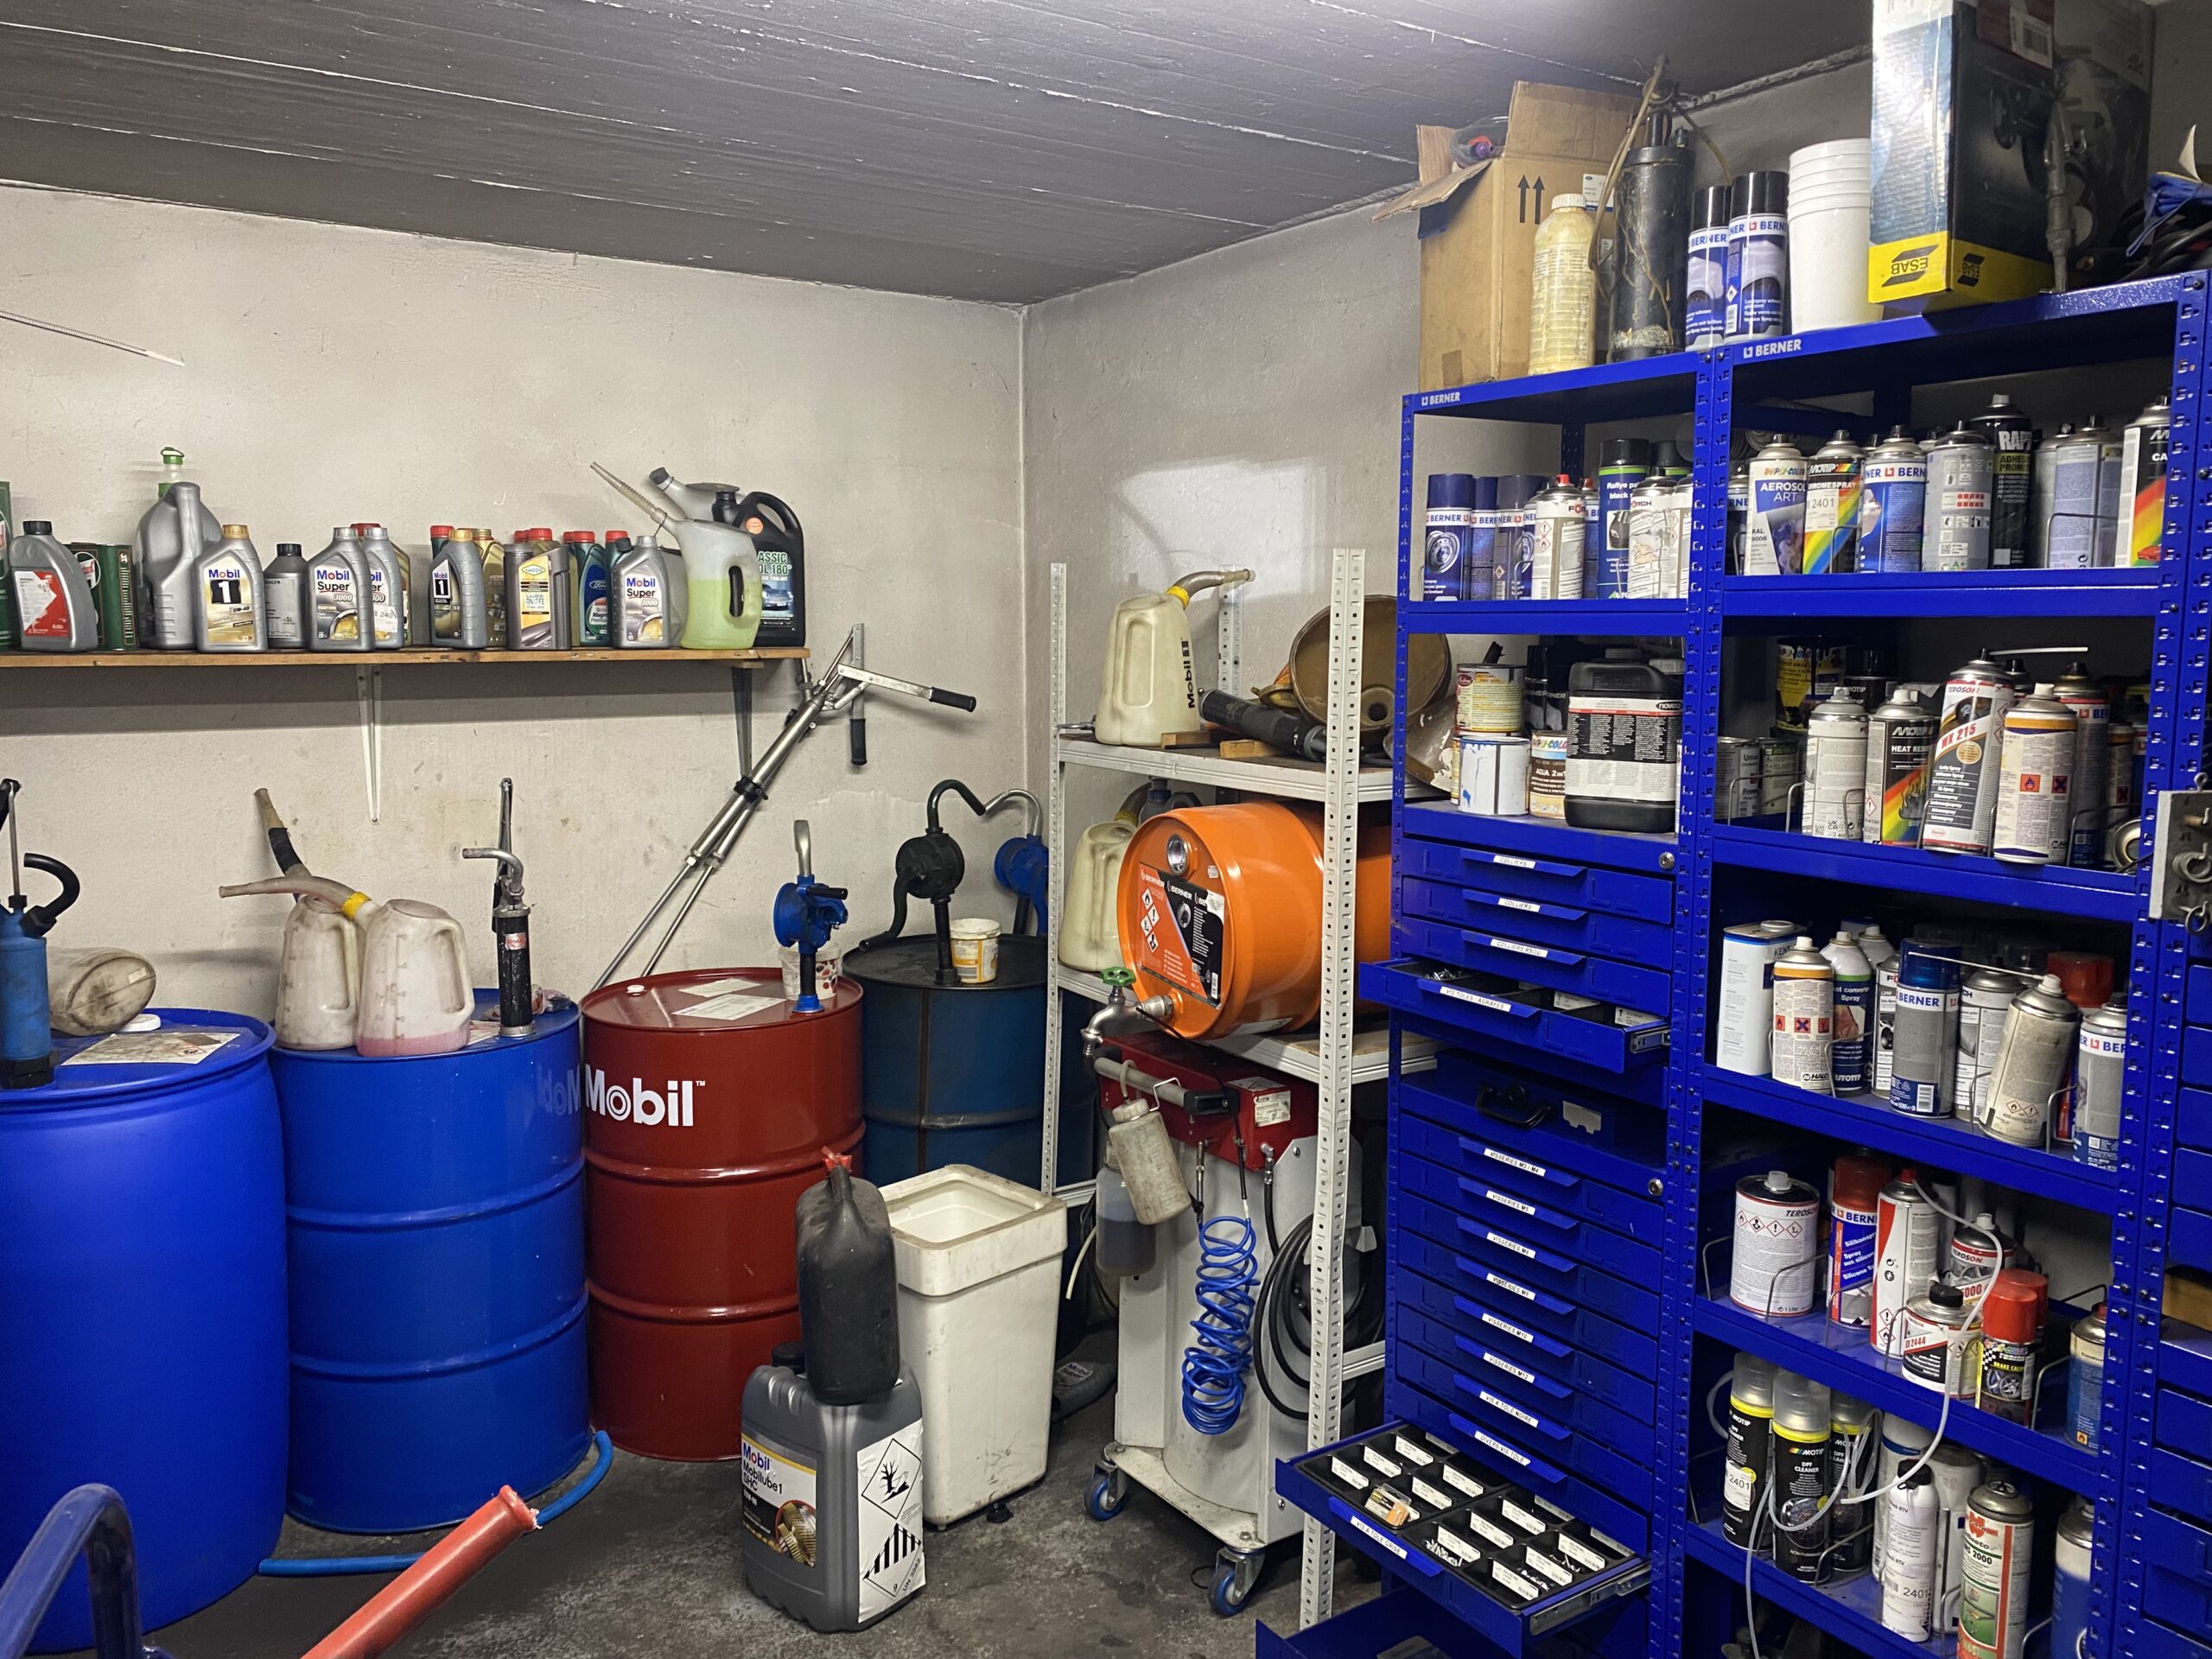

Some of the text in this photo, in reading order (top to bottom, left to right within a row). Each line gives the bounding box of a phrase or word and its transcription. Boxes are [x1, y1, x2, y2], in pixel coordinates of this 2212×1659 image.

[1691, 232, 1726, 246] BERNER
[1891, 257, 1928, 275] ESAB
[1755, 340, 1802, 356] BERNER
[1429, 392, 1460, 405] BERNER
[1760, 481, 1806, 492] AEROSOL
[1773, 492, 1797, 502] ART
[208, 569, 240, 578] Mobil
[316, 569, 350, 580] Mobil
[317, 581, 350, 592] Super
[438, 580, 445, 595] 1
[626, 577, 656, 588] Mobil
[218, 581, 232, 603] 1
[334, 594, 353, 602] 3000
[626, 588, 656, 598] Super
[1183, 660, 1195, 709] Mobil
[1956, 724, 1976, 741] 215
[1499, 857, 1527, 867] COLLIERS
[1144, 874, 1166, 888] BERNER
[1170, 884, 1192, 900] BERNER
[1504, 899, 1532, 910] COLLIERS
[1497, 941, 1524, 952] COLLIERS
[1478, 997, 1504, 1010] AGRAFES
[1898, 992, 1940, 1007] BERNER
[585, 1063, 694, 1127] Mobil
[1490, 1151, 1518, 1166] VISSERIES
[1492, 1193, 1520, 1209] VISSERIES
[1492, 1236, 1521, 1251] VISSERIES
[1843, 1250, 1862, 1260] Spray
[1953, 1249, 1983, 1263] TEROSON
[1492, 1276, 1521, 1294] VISSERIES
[1488, 1317, 1528, 1339] VISSERIES M10
[1489, 1356, 1529, 1380] VISSERIES M12
[1500, 1402, 1515, 1414] TOLE
[1515, 1411, 1532, 1424] NOIRE
[743, 1442, 770, 1471] Mobil
[1480, 1435, 1524, 1464] DIVERS VIS TOLE
[743, 1472, 758, 1491] SHC
[1729, 1474, 1750, 1491] 2401
[1356, 1521, 1365, 1529] VIS
[1370, 1530, 1383, 1543] TOLE
[1384, 1539, 1402, 1554] GRISE
[1973, 1549, 1993, 1565] 2000
[910, 1557, 921, 1577] 3082
